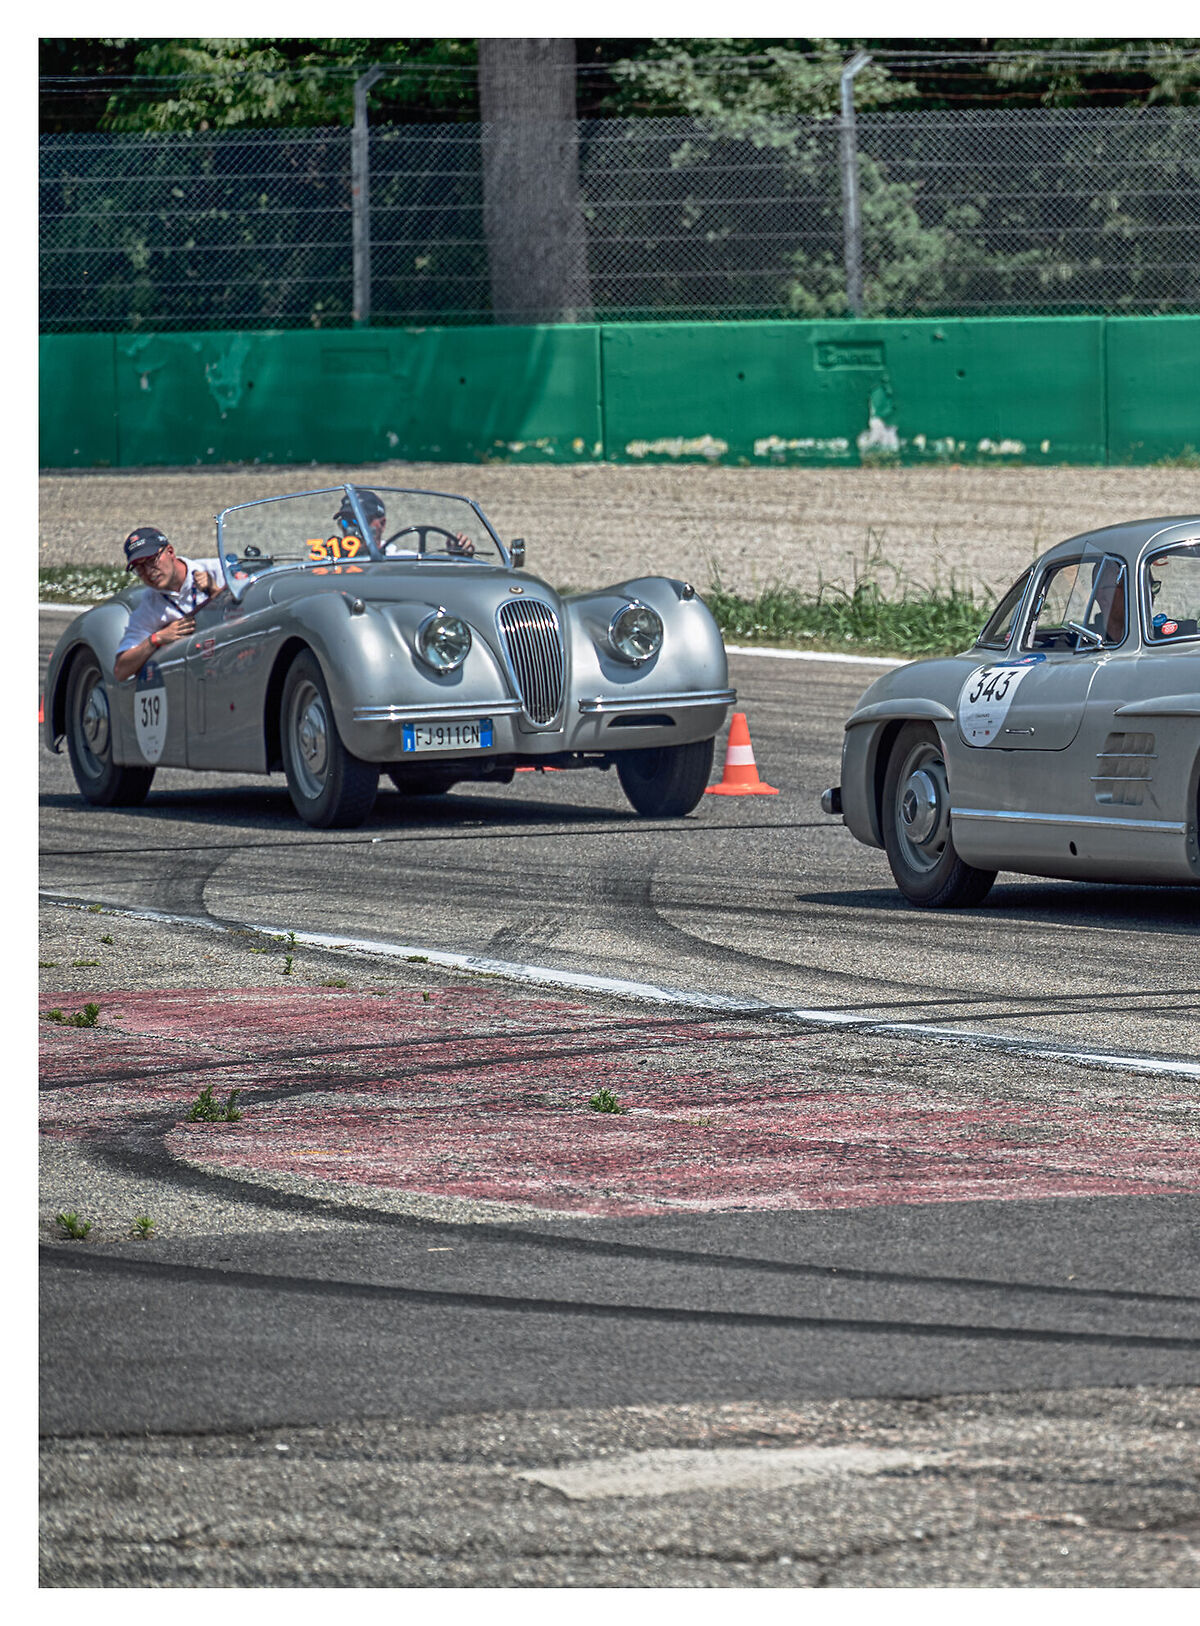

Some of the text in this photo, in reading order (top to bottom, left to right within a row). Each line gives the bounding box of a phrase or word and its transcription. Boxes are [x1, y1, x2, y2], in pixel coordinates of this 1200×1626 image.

[306, 535, 361, 561] 319
[969, 671, 1019, 704] 343
[141, 695, 161, 728] 319
